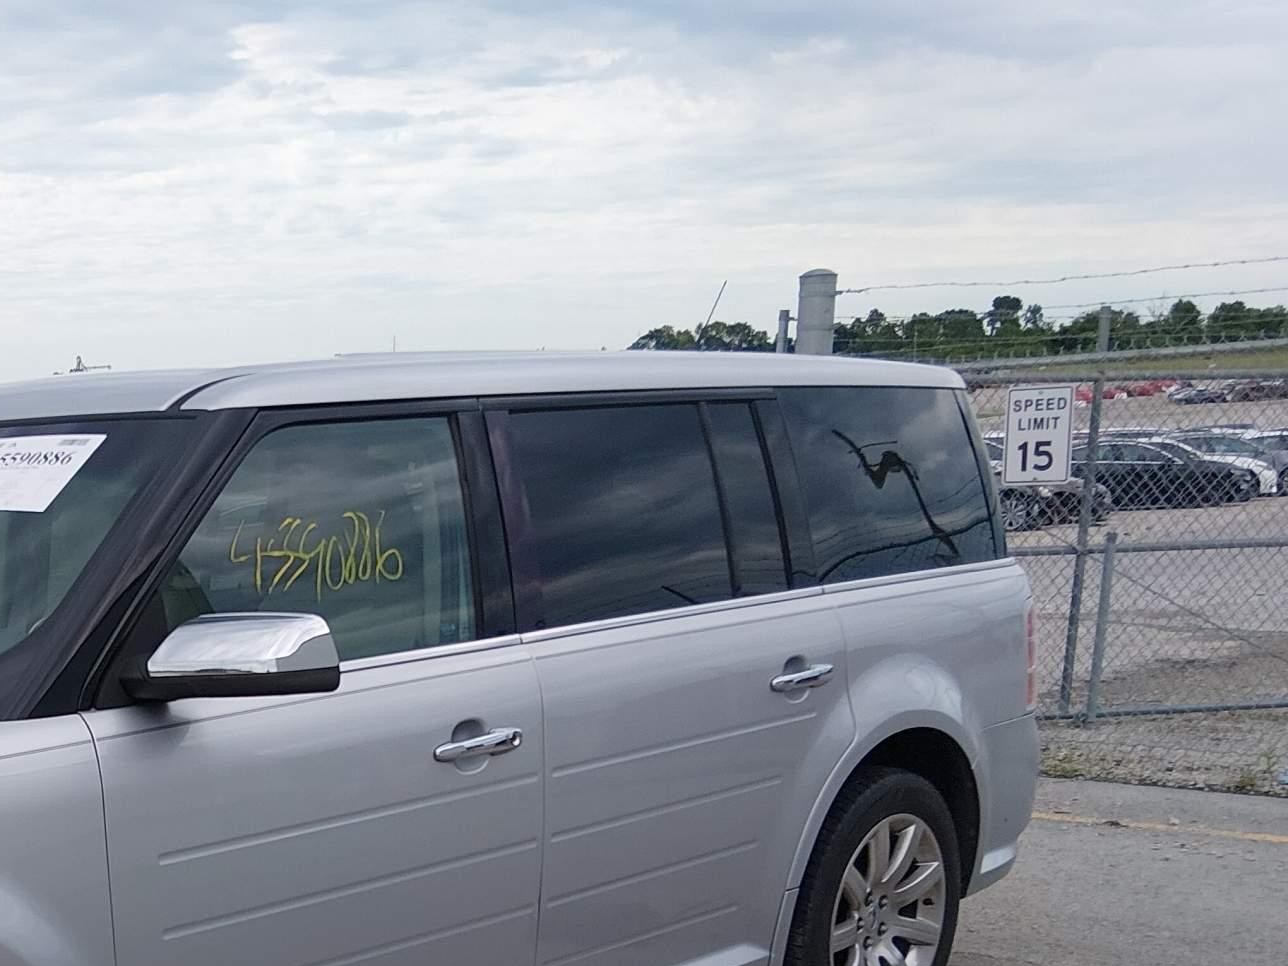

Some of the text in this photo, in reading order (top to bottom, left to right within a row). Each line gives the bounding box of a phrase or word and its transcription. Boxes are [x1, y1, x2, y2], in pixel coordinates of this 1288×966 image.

[1013, 397, 1067, 412] SPEED
[1017, 417, 1060, 431] LIMIT
[1017, 440, 1053, 472] 15
